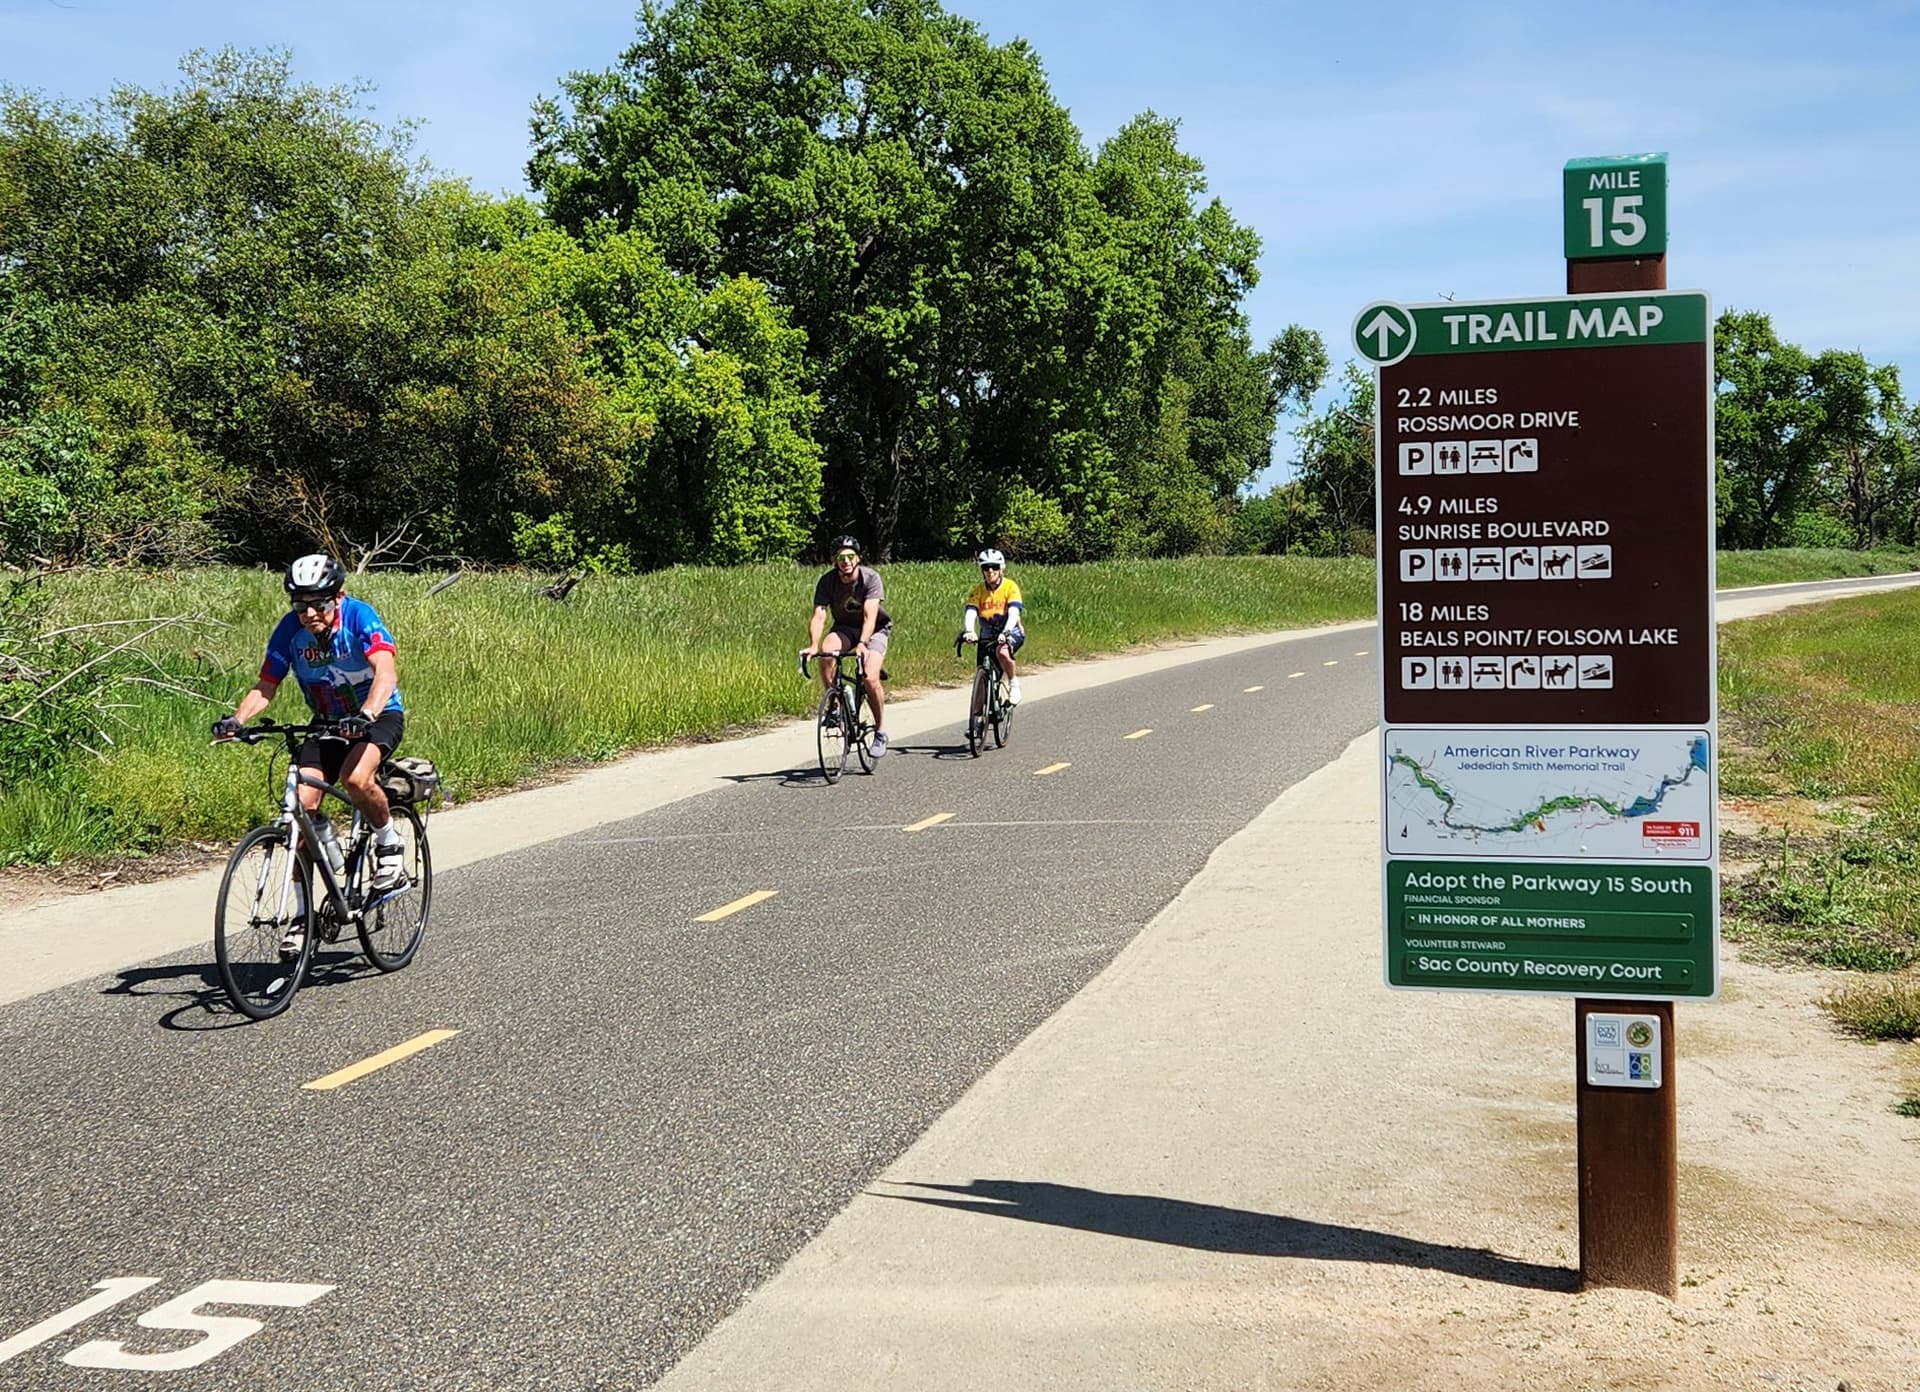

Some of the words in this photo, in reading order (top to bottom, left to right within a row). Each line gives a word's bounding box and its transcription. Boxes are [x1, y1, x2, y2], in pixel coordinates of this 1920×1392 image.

[1589, 172, 1641, 190] MILE
[1582, 196, 1646, 247] 15
[1443, 310, 1556, 345] TRAIL
[1566, 306, 1663, 339] MAP
[1398, 388, 1431, 408] 2.2
[1439, 389, 1497, 405] MILES
[1398, 414, 1514, 432] ROSSMOOR
[1521, 411, 1579, 429] DRIVE
[1398, 496, 1431, 515] 4.9
[1439, 499, 1498, 514] MILES
[1399, 524, 1481, 540] SUNRISE
[1488, 521, 1609, 538] BOULEVARD
[1400, 603, 1423, 621] 18
[1431, 606, 1489, 621] MILES
[1400, 631, 1458, 646] BEALS
[1537, 630, 1621, 645] FOLSOM
[1629, 629, 1678, 645] LAKE
[1444, 745, 1521, 758] American
[1526, 745, 1565, 758] River
[1569, 746, 1640, 761] Parkway
[1457, 761, 1509, 771] Jedediah
[1512, 762, 1543, 771] Smith
[1546, 762, 1599, 771] Memorial
[1602, 762, 1625, 771] Trail
[1679, 827, 1694, 836] 911
[1405, 873, 1466, 891] Adopt
[1472, 873, 1506, 890] the
[1512, 875, 1601, 895] Parkway
[1606, 877, 1625, 892] 15
[1631, 877, 1692, 894] South
[1404, 894, 1453, 904] FINANCIAL
[1455, 897, 1500, 905] SPONSOR
[1418, 915, 1430, 924] IN
[1434, 915, 1478, 926] HONOR
[1482, 916, 1498, 927] OF
[1502, 916, 1524, 927] ALL
[1527, 917, 1585, 929] MOTHERS
[1405, 940, 1459, 949] VOLUNTEER
[1460, 941, 1506, 950] STEWARD
[1419, 957, 1452, 972] Sac
[1456, 958, 1519, 976] County
[1524, 961, 1606, 980] Recovery
[1611, 963, 1662, 979] Court
[0, 1277, 337, 1371] 15
